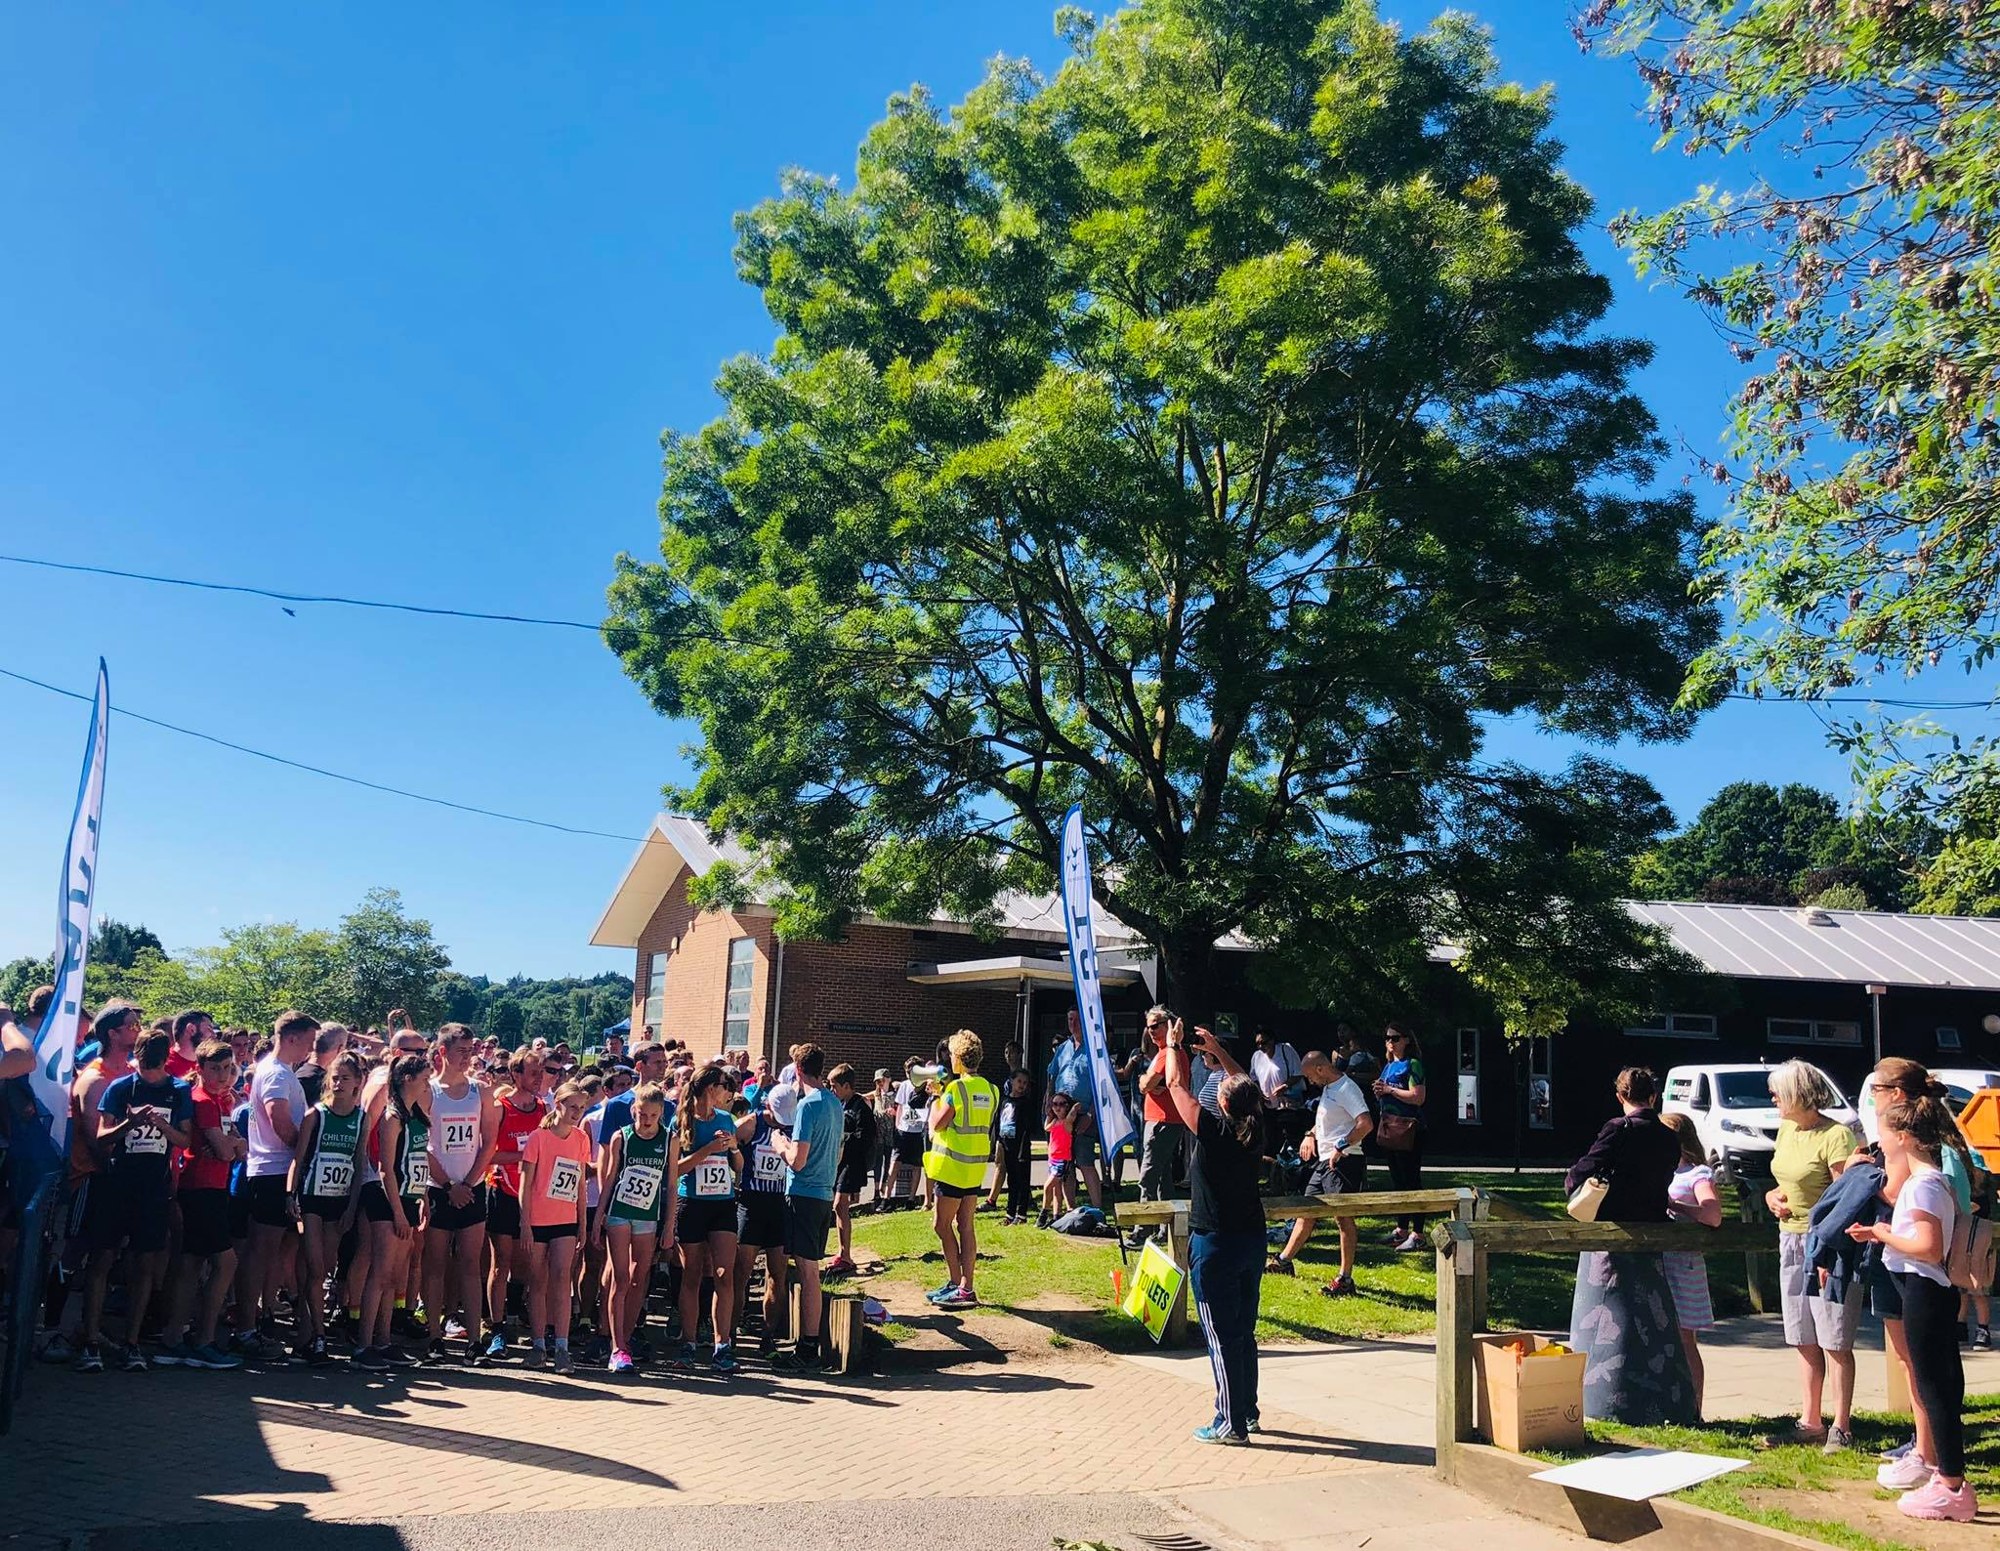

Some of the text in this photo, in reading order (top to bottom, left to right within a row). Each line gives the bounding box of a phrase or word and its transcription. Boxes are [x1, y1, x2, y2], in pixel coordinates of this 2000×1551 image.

[447, 1125, 473, 1142] 214
[628, 1157, 664, 1166] CHILTERN
[761, 1156, 781, 1172] 187
[322, 1166, 349, 1184] 502
[555, 1171, 577, 1191] 579
[704, 1167, 726, 1184] 152
[625, 1176, 653, 1198] 553
[1138, 1269, 1170, 1311] TOILETS
